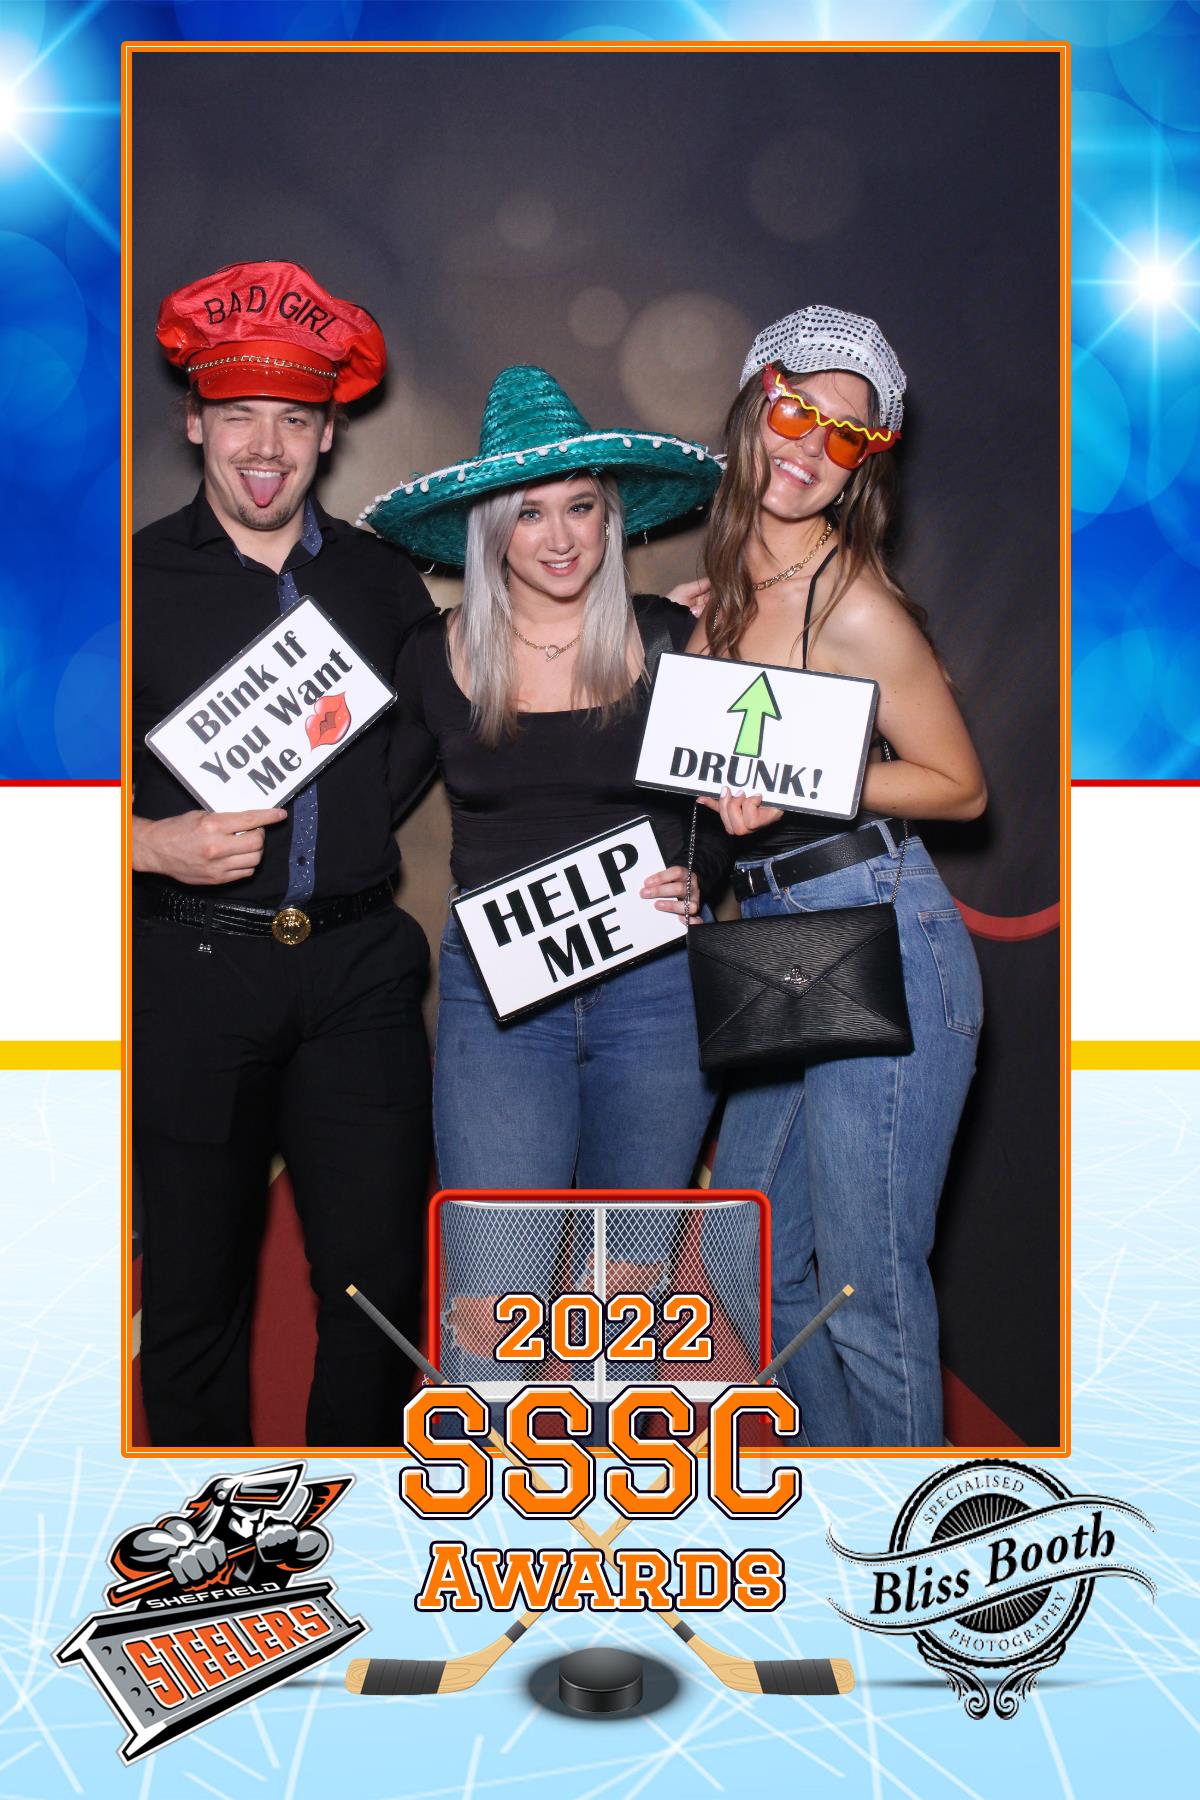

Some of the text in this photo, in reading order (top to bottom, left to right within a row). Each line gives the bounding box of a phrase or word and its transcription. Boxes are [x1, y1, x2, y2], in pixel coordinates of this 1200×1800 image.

[204, 286, 337, 341] BAD GIRL
[185, 630, 307, 744] Blink If
[200, 648, 352, 784] You Want
[247, 748, 302, 796] Me
[669, 746, 823, 799] DRUNK!
[483, 842, 639, 947] HELP
[537, 907, 634, 983] ME
